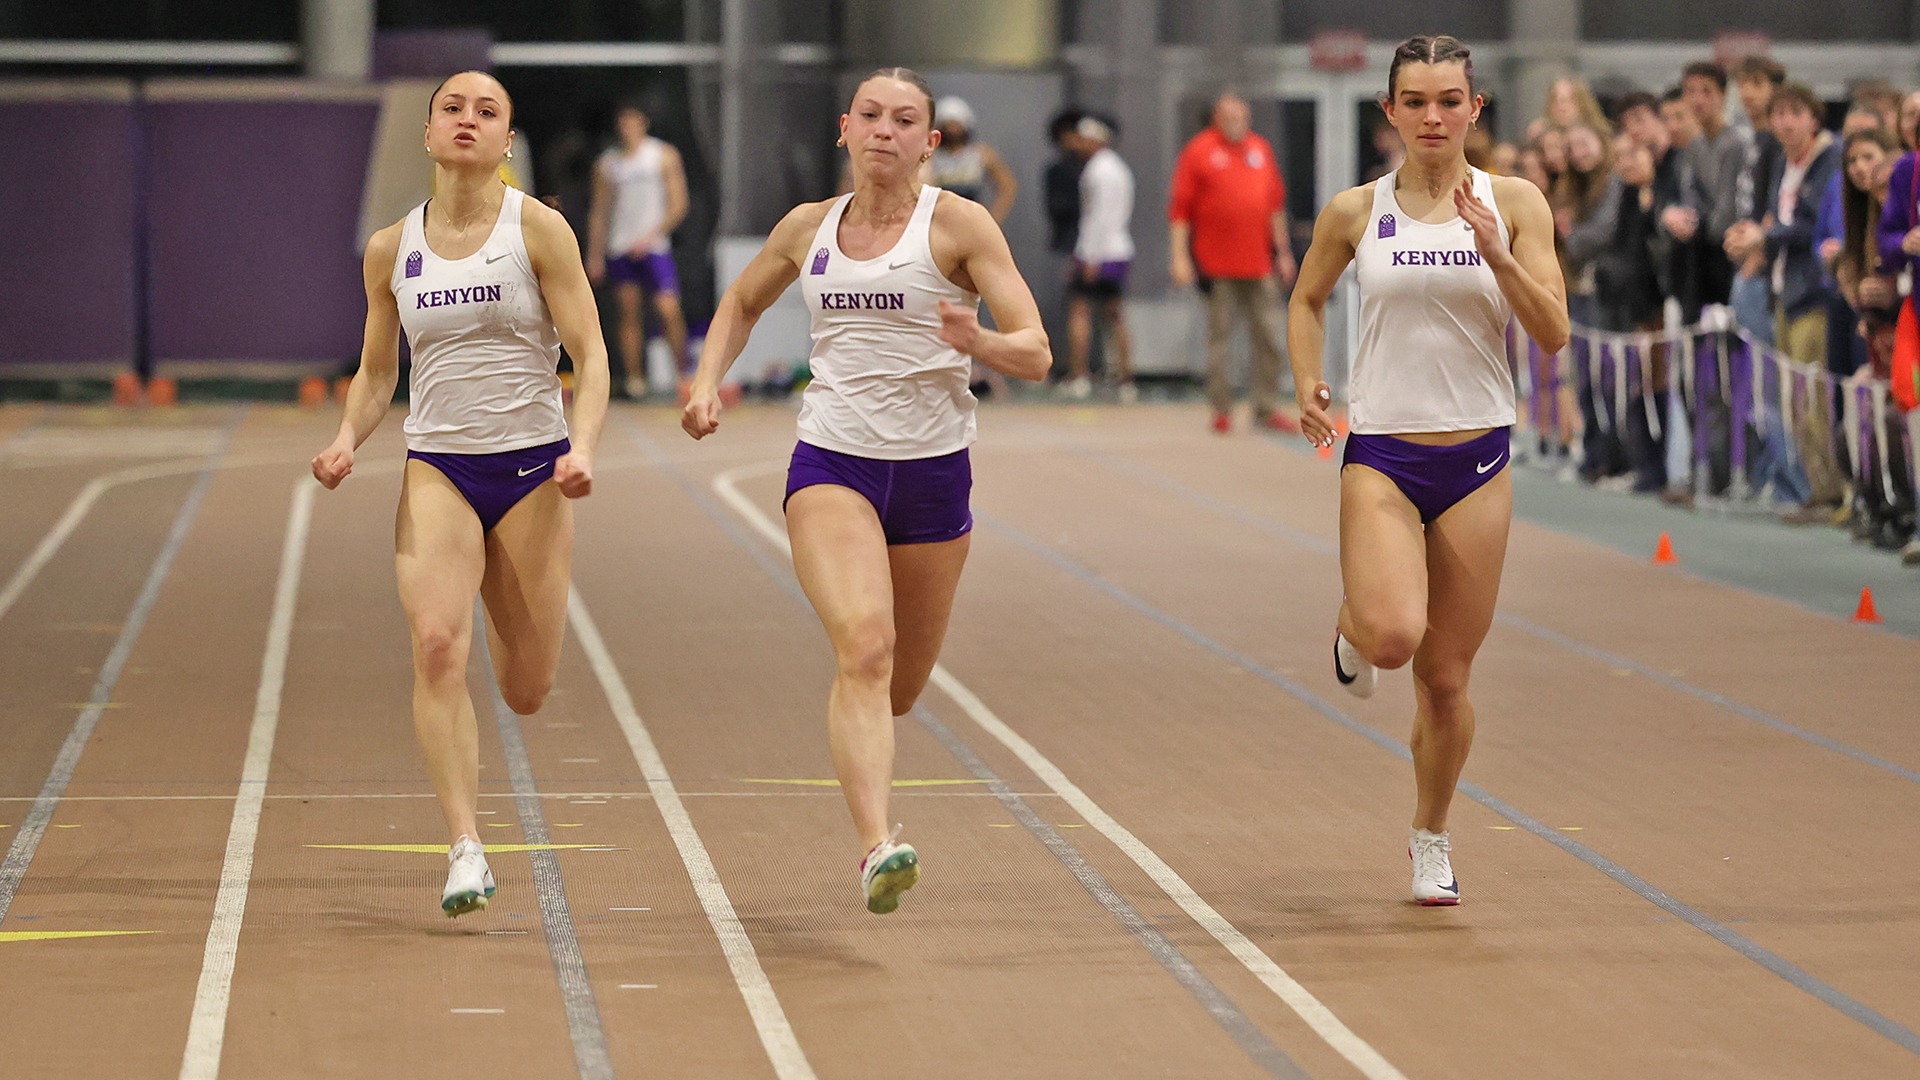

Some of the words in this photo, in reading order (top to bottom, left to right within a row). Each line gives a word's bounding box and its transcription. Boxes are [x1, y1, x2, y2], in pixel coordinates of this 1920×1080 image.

[1392, 250, 1481, 267] KENYON
[416, 285, 502, 310] KENYON
[820, 293, 905, 310] KENYON
